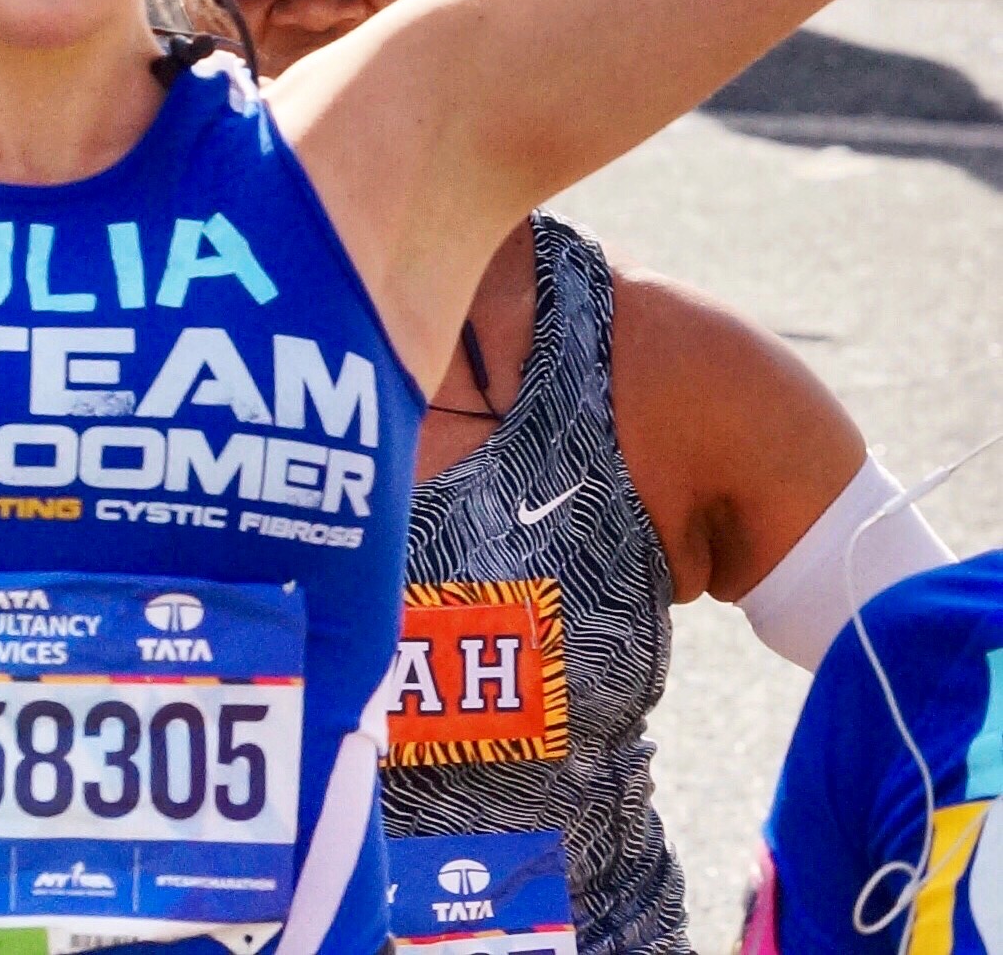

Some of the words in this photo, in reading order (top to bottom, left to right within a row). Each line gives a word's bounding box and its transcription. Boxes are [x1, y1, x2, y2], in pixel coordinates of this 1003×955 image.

[96, 499, 228, 528] CYSTIC
[136, 638, 213, 662] TATA
[432, 900, 494, 922] TATA
